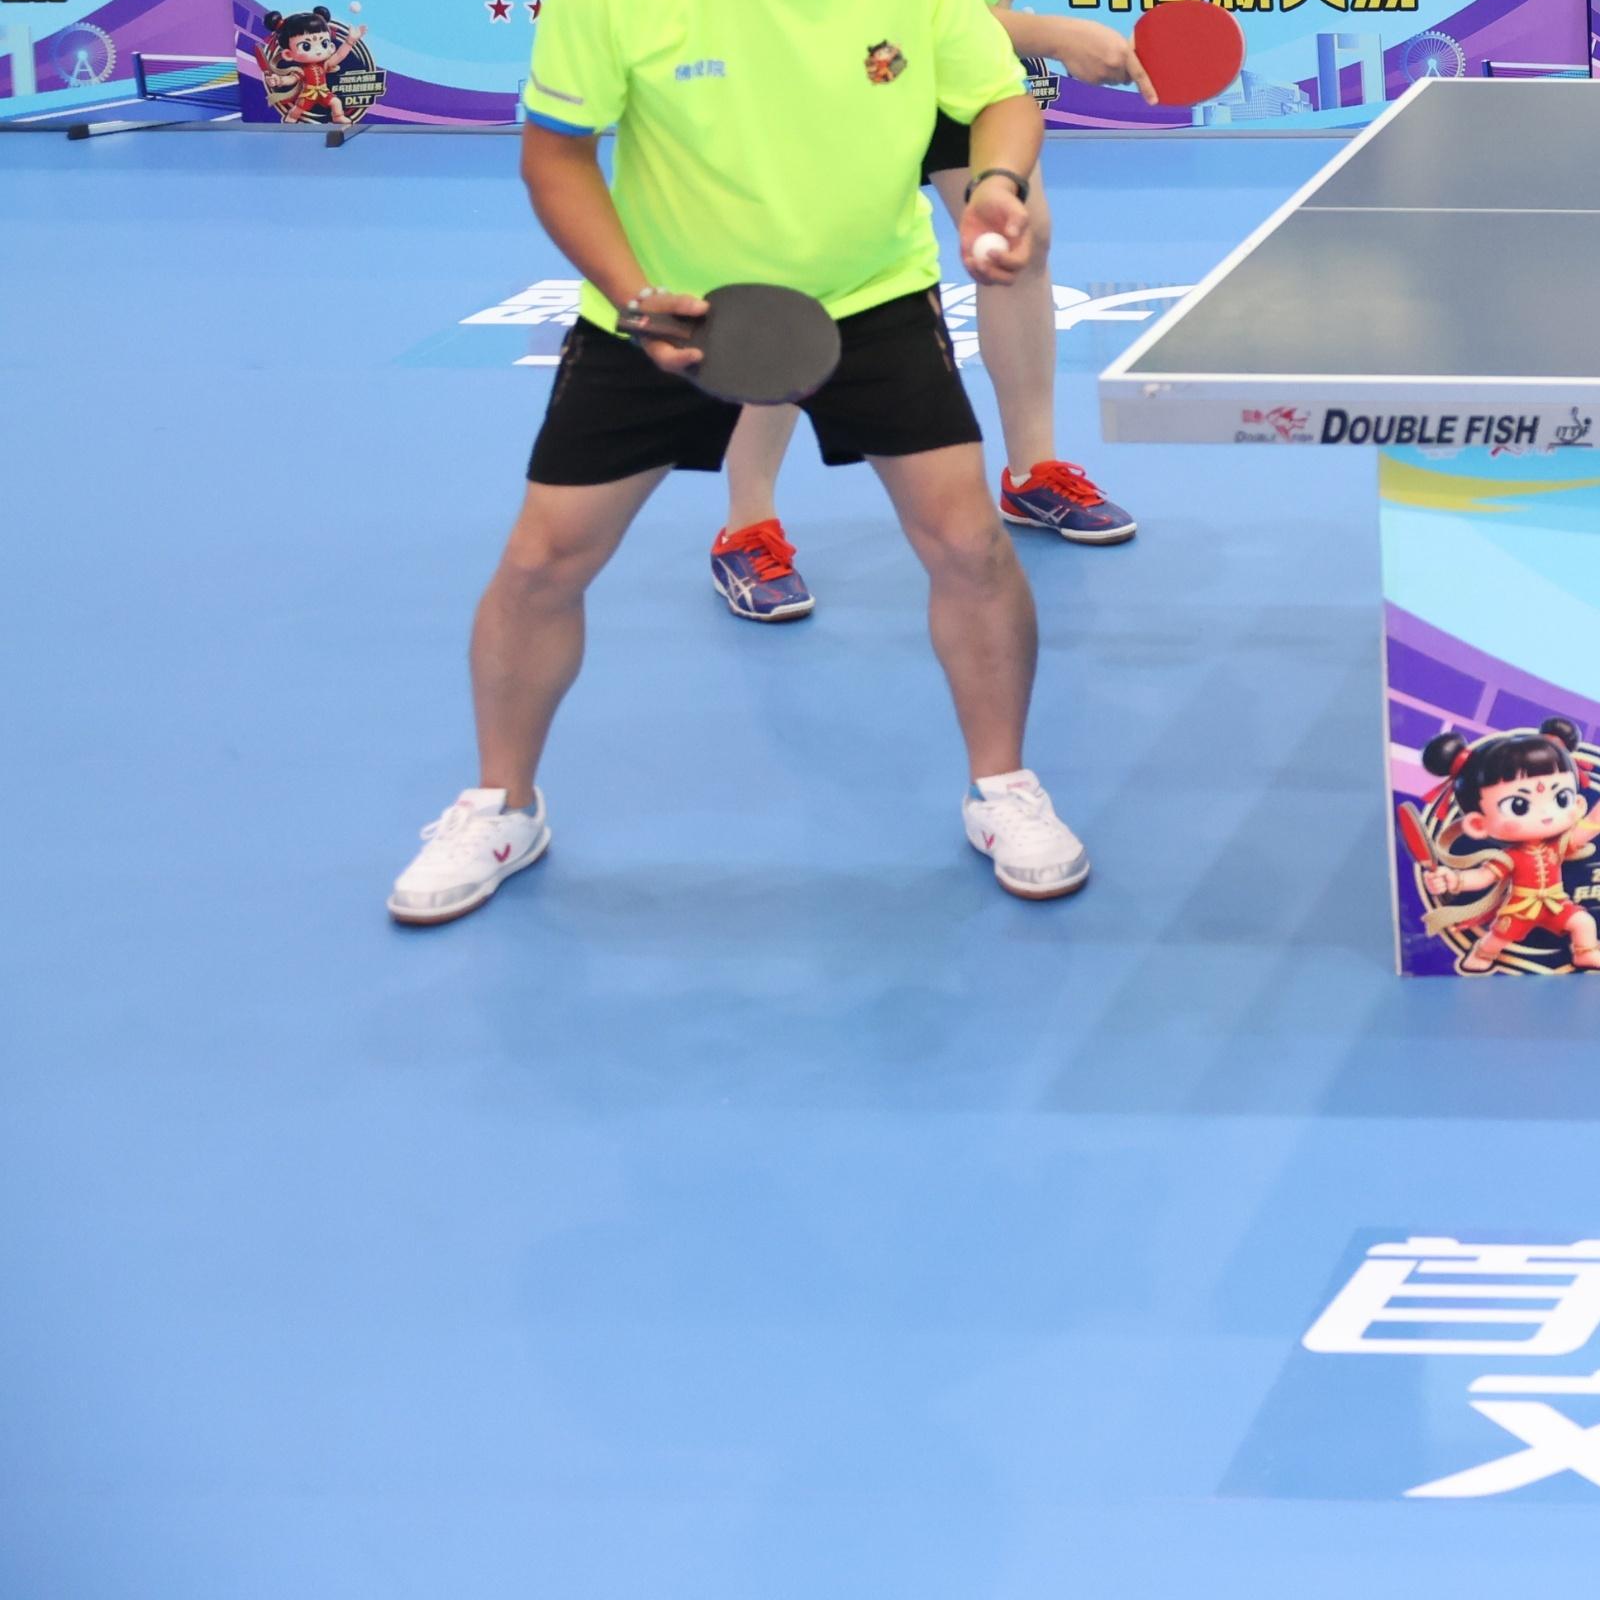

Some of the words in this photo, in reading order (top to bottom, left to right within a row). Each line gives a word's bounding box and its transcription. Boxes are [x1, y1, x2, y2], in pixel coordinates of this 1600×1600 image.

[345, 96, 371, 106] DLTT
[1320, 408, 1458, 445] DOUBLE
[1463, 415, 1540, 445] FISH
